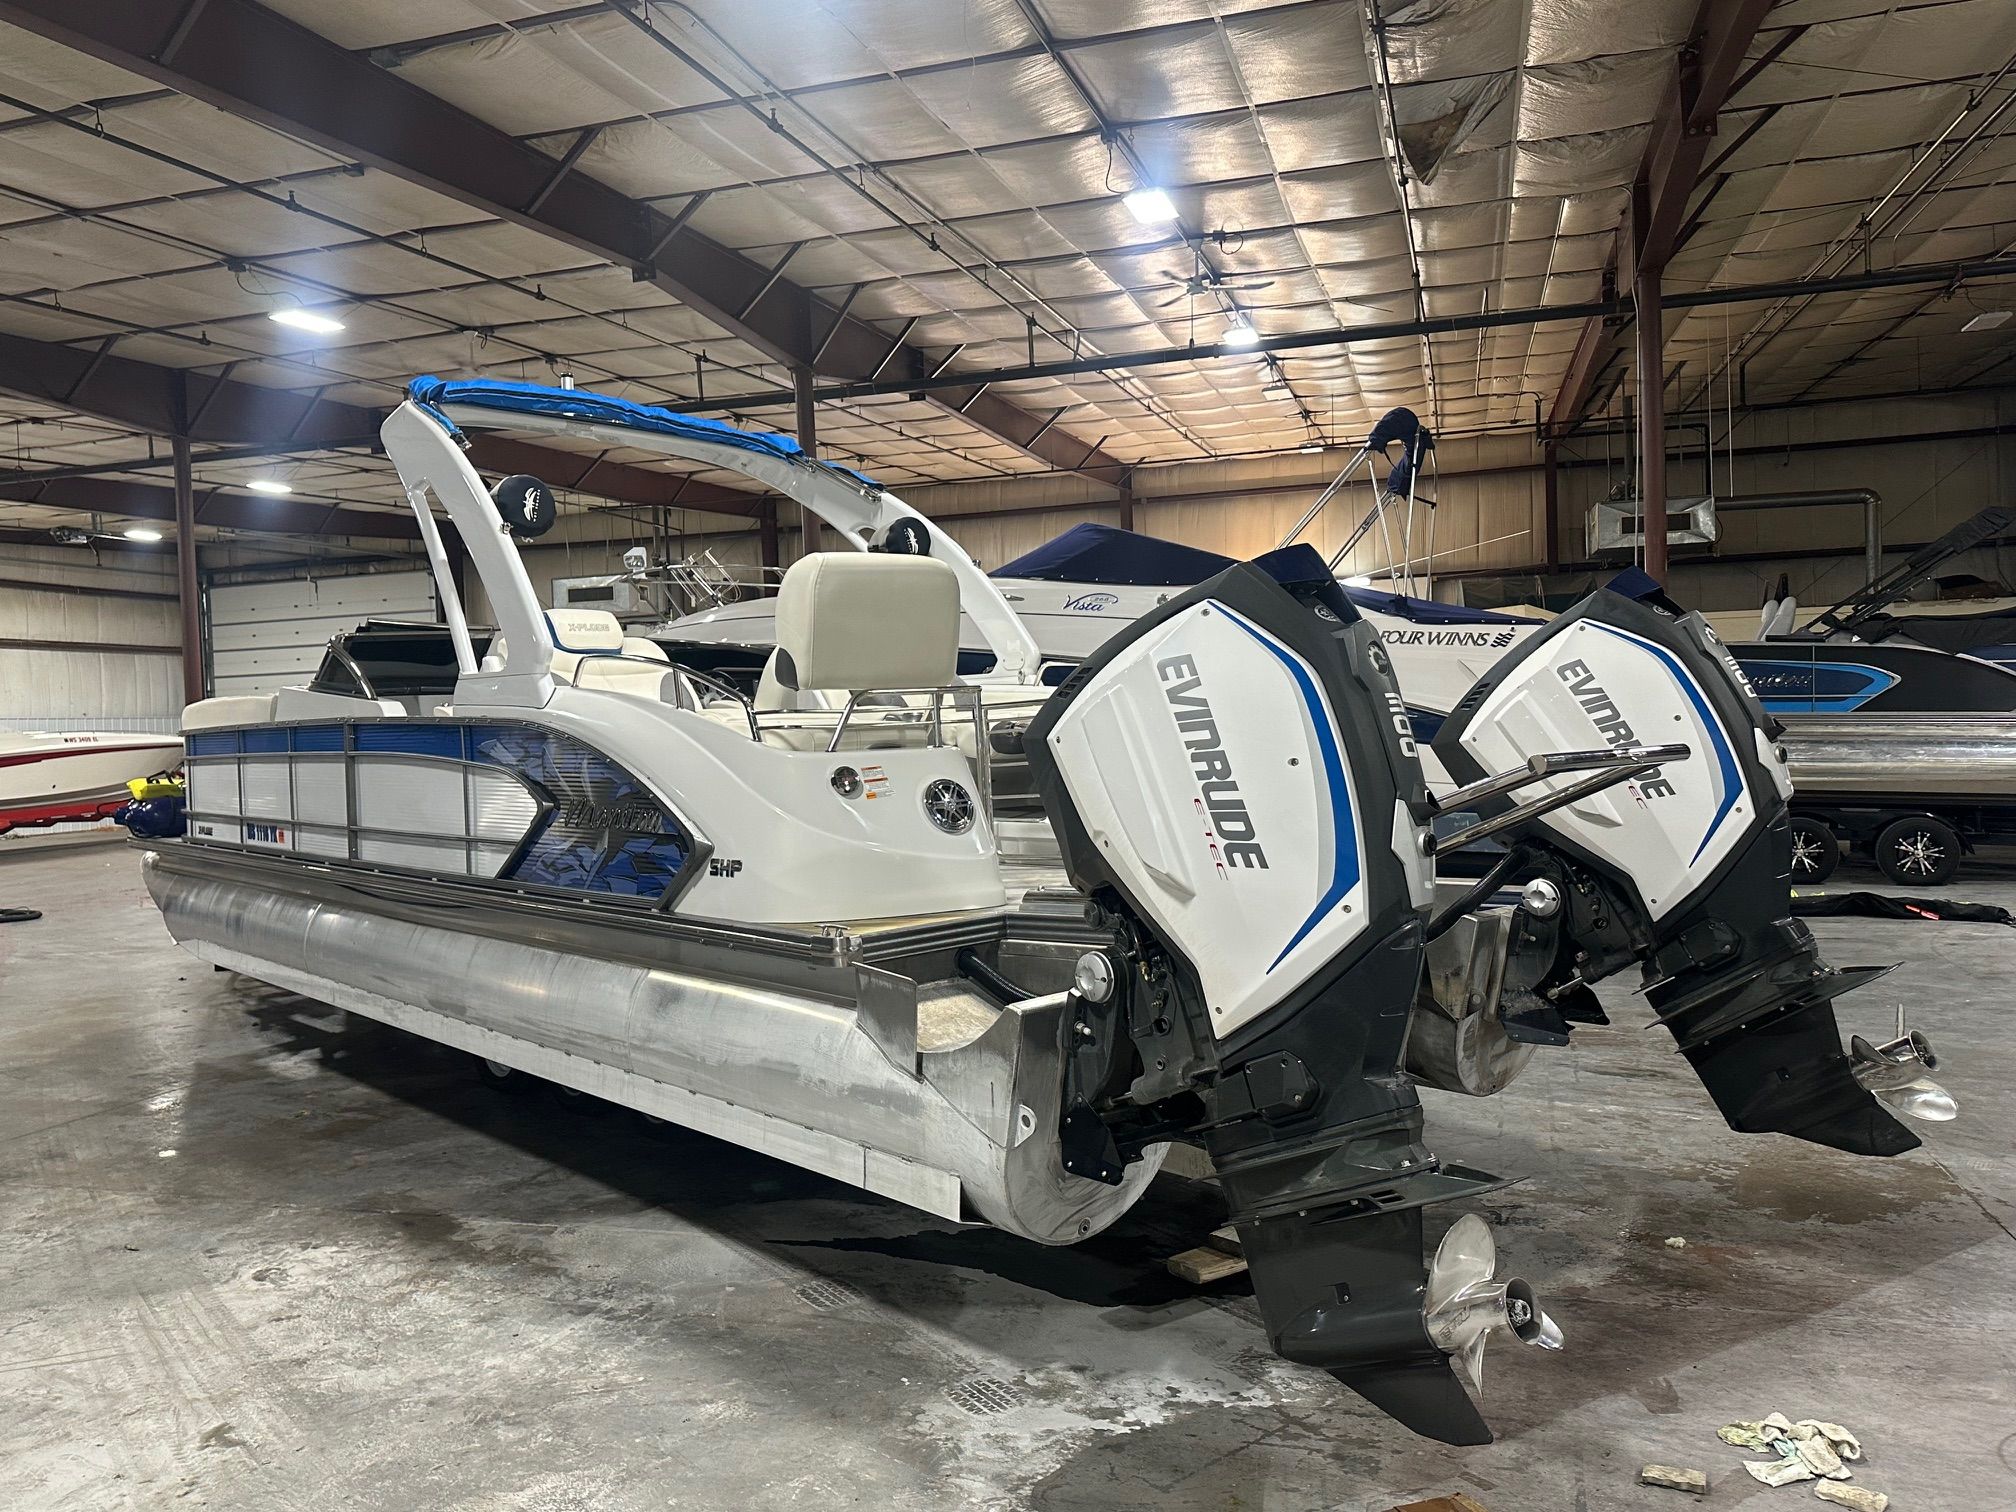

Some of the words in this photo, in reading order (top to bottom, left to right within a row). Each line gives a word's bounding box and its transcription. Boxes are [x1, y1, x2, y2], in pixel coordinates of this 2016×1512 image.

[1062, 592, 1118, 612] Vista
[1381, 630, 1425, 646] FOUR
[1428, 631, 1490, 647] WINNS
[1156, 653, 1270, 870] EVINRUDE
[1193, 798, 1229, 881] E-TEC
[710, 858, 743, 878] SHP
